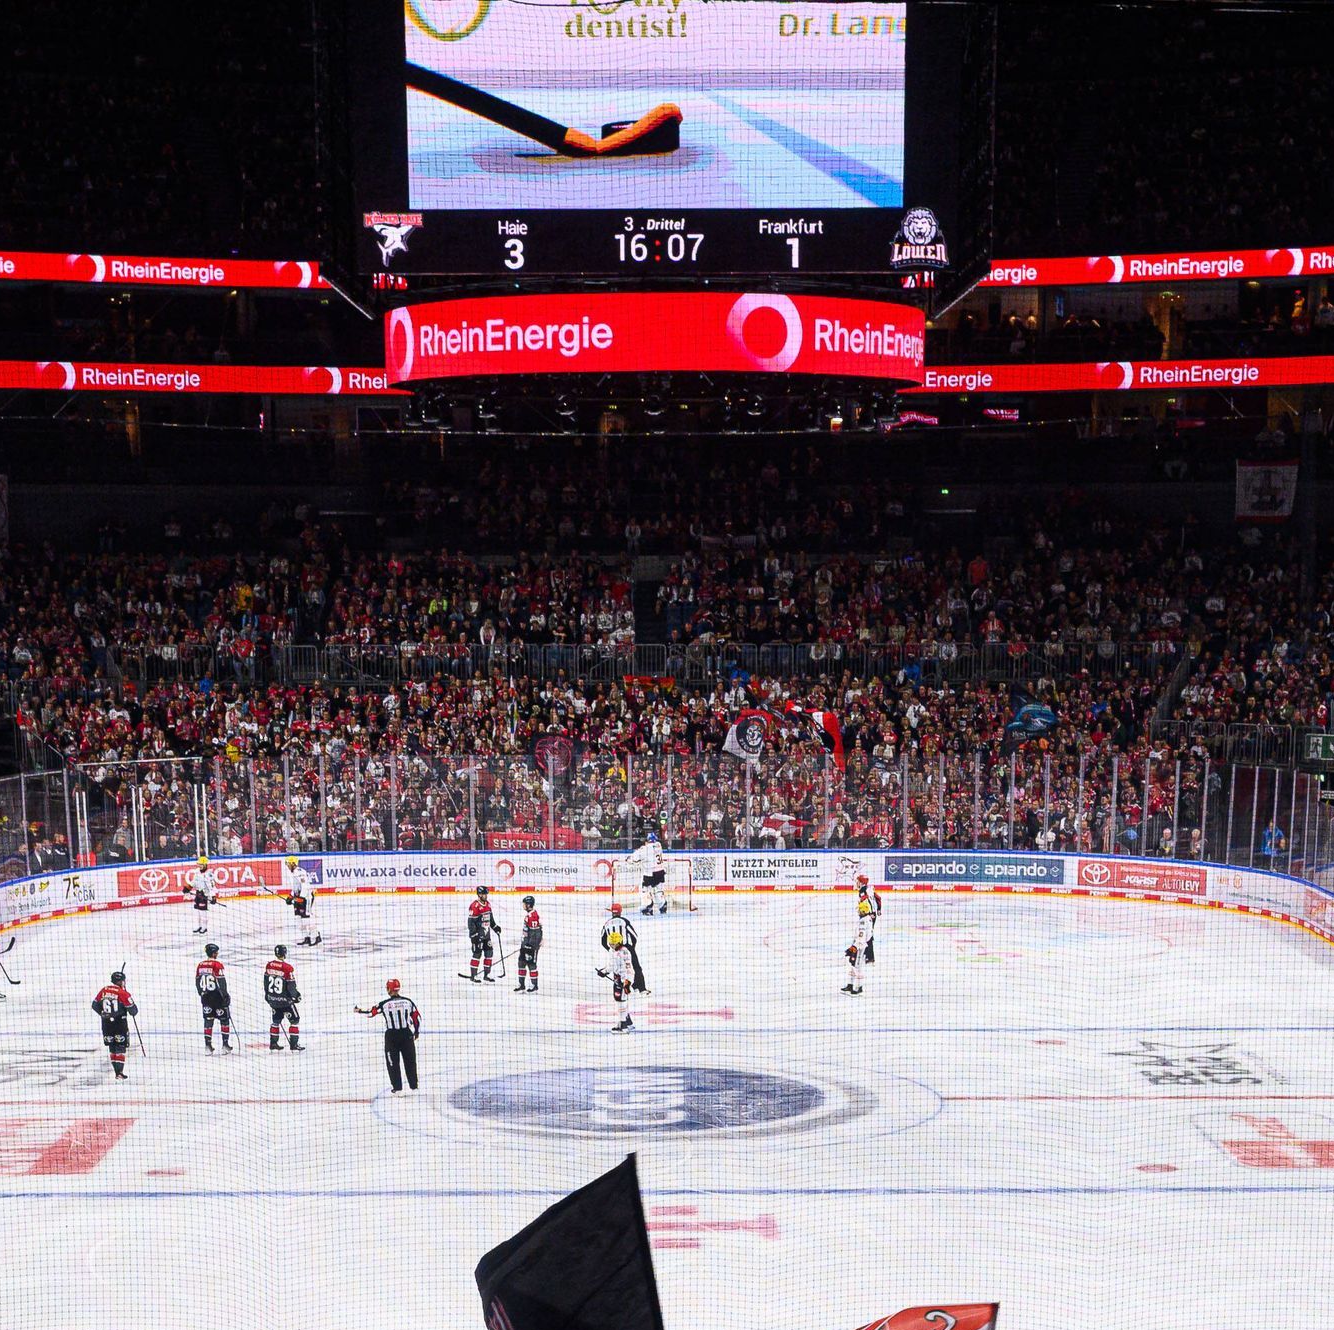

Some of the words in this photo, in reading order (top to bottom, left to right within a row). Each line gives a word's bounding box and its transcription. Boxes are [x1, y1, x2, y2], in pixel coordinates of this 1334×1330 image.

[564, 13, 687, 38] dentist!
[780, 15, 819, 37] Dr.
[497, 219, 527, 236] Haie
[624, 217, 633, 231] 3
[759, 218, 823, 236] Frankfurt
[504, 239, 525, 269] 3
[615, 233, 704, 262] 16:07
[787, 239, 801, 268] 1
[892, 243, 947, 262] LÖWEN
[112, 261, 225, 285] RheinEnergie
[983, 263, 1037, 283] nergie
[1130, 257, 1244, 280] RheinEnergie
[420, 316, 613, 358] RheinEnergie
[82, 367, 200, 392] RheinEnergie
[924, 370, 993, 391] Energie
[1140, 363, 1259, 386] RheinEnergie
[492, 838, 547, 850] SEKTION
[326, 864, 477, 878] www.axa-decker.de
[518, 865, 578, 876] RheinEnergie
[731, 858, 764, 868] JETZT
[767, 858, 818, 868] MITGLIED
[902, 860, 966, 877] apiando
[984, 863, 1047, 878] apiando
[172, 866, 256, 886] TOOTA
[731, 868, 780, 879] WERDEN!
[77, 890, 95, 902] CGN
[199, 975, 215, 991] 46
[268, 976, 283, 994] 29
[103, 998, 118, 1013] 61
